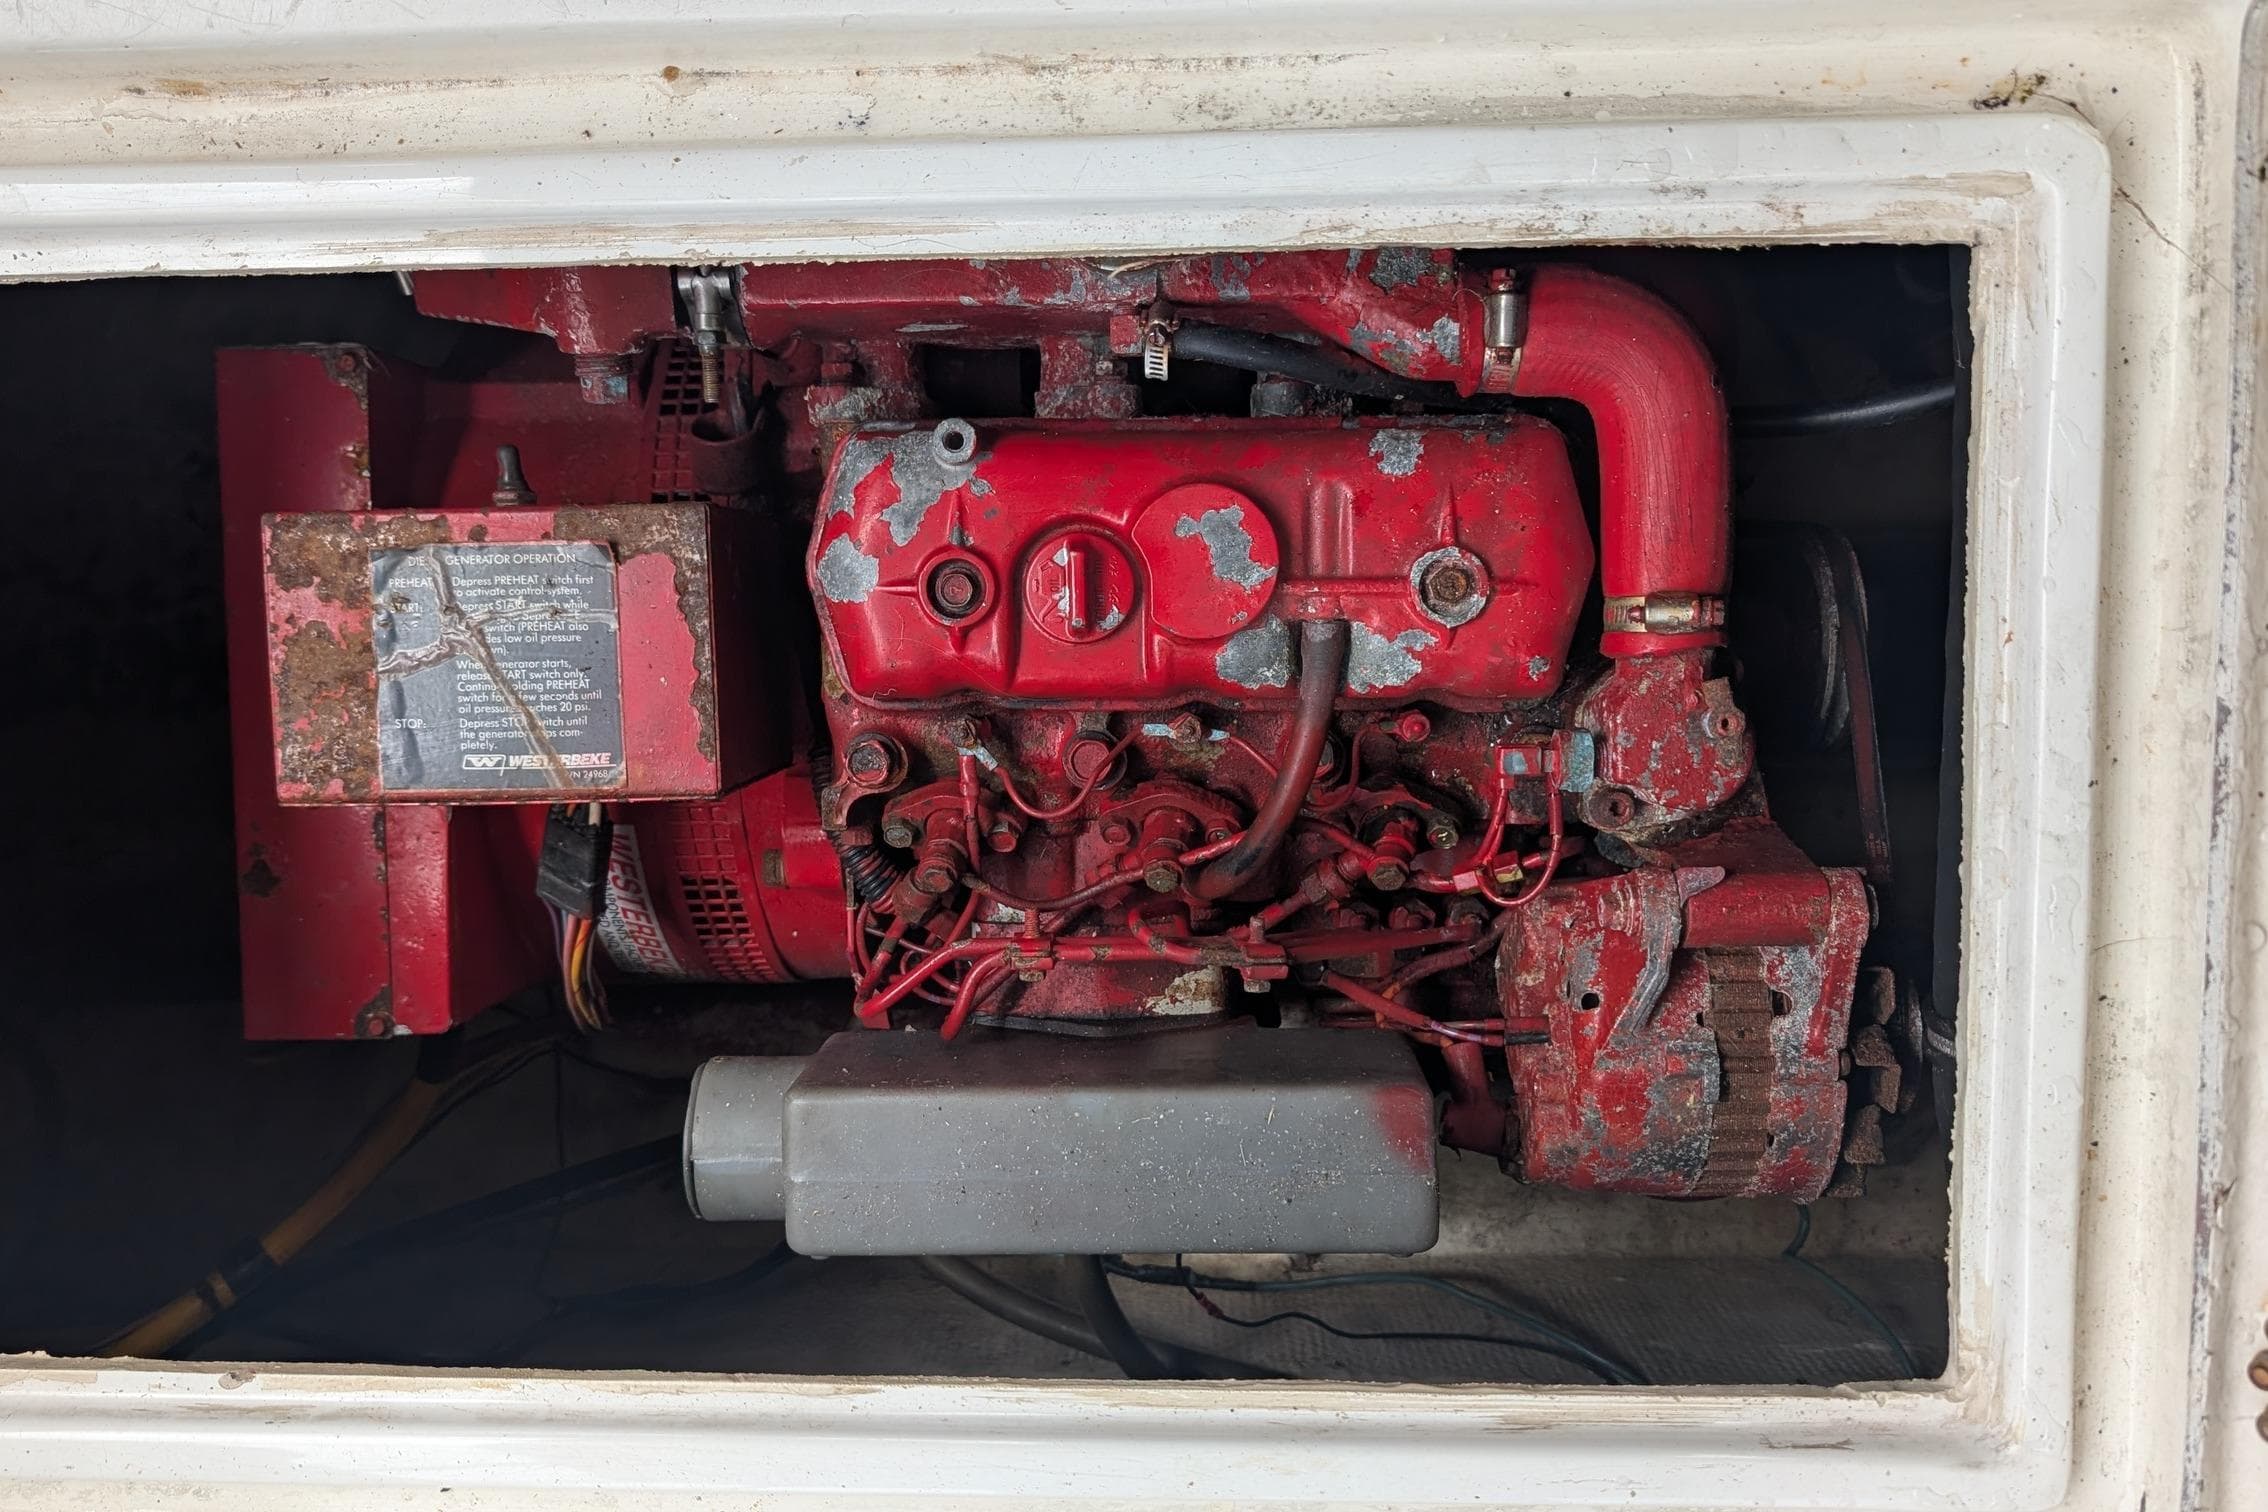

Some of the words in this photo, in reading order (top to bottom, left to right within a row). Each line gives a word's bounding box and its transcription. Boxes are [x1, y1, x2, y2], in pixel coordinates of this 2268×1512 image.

[445, 554, 510, 566] GENERATOR
[513, 553, 576, 564] OPERATION
[452, 577, 492, 588] Depress
[494, 575, 539, 585] PREHEAT
[542, 574, 572, 585] sitch
[575, 574, 594, 584] first
[465, 587, 506, 596] activate
[508, 586, 544, 596] control
[495, 600, 526, 610] START
[563, 599, 589, 609] while
[485, 620, 515, 632] switch
[517, 621, 565, 633] (PREHEAT
[569, 621, 589, 632] also
[504, 632, 523, 643] low
[525, 632, 538, 643] oil
[541, 634, 582, 645] pressure
[496, 660, 540, 669] nerator
[542, 659, 572, 669] starts,
[501, 669, 527, 679] TART
[529, 669, 560, 679] switch
[563, 669, 587, 682] only.
[457, 682, 498, 692] Continu
[511, 680, 544, 692] olding
[546, 679, 590, 690] PREHEAT
[457, 692, 489, 703] switch
[518, 691, 537, 701] few
[539, 690, 579, 701] seconds
[581, 689, 602, 700] until
[458, 703, 472, 714] oil
[529, 702, 557, 712] ches
[560, 702, 572, 712] 20
[574, 702, 591, 713] psi.
[394, 718, 427, 729] STOP:
[460, 718, 499, 730] Depress
[502, 717, 526, 728] STO
[540, 716, 564, 727] itch
[567, 716, 588, 726] until
[460, 729, 476, 739] the
[559, 730, 583, 738] com-
[460, 740, 499, 752] pletely.
[508, 752, 612, 767] WESTRBEKE
[584, 770, 609, 779] 24968
